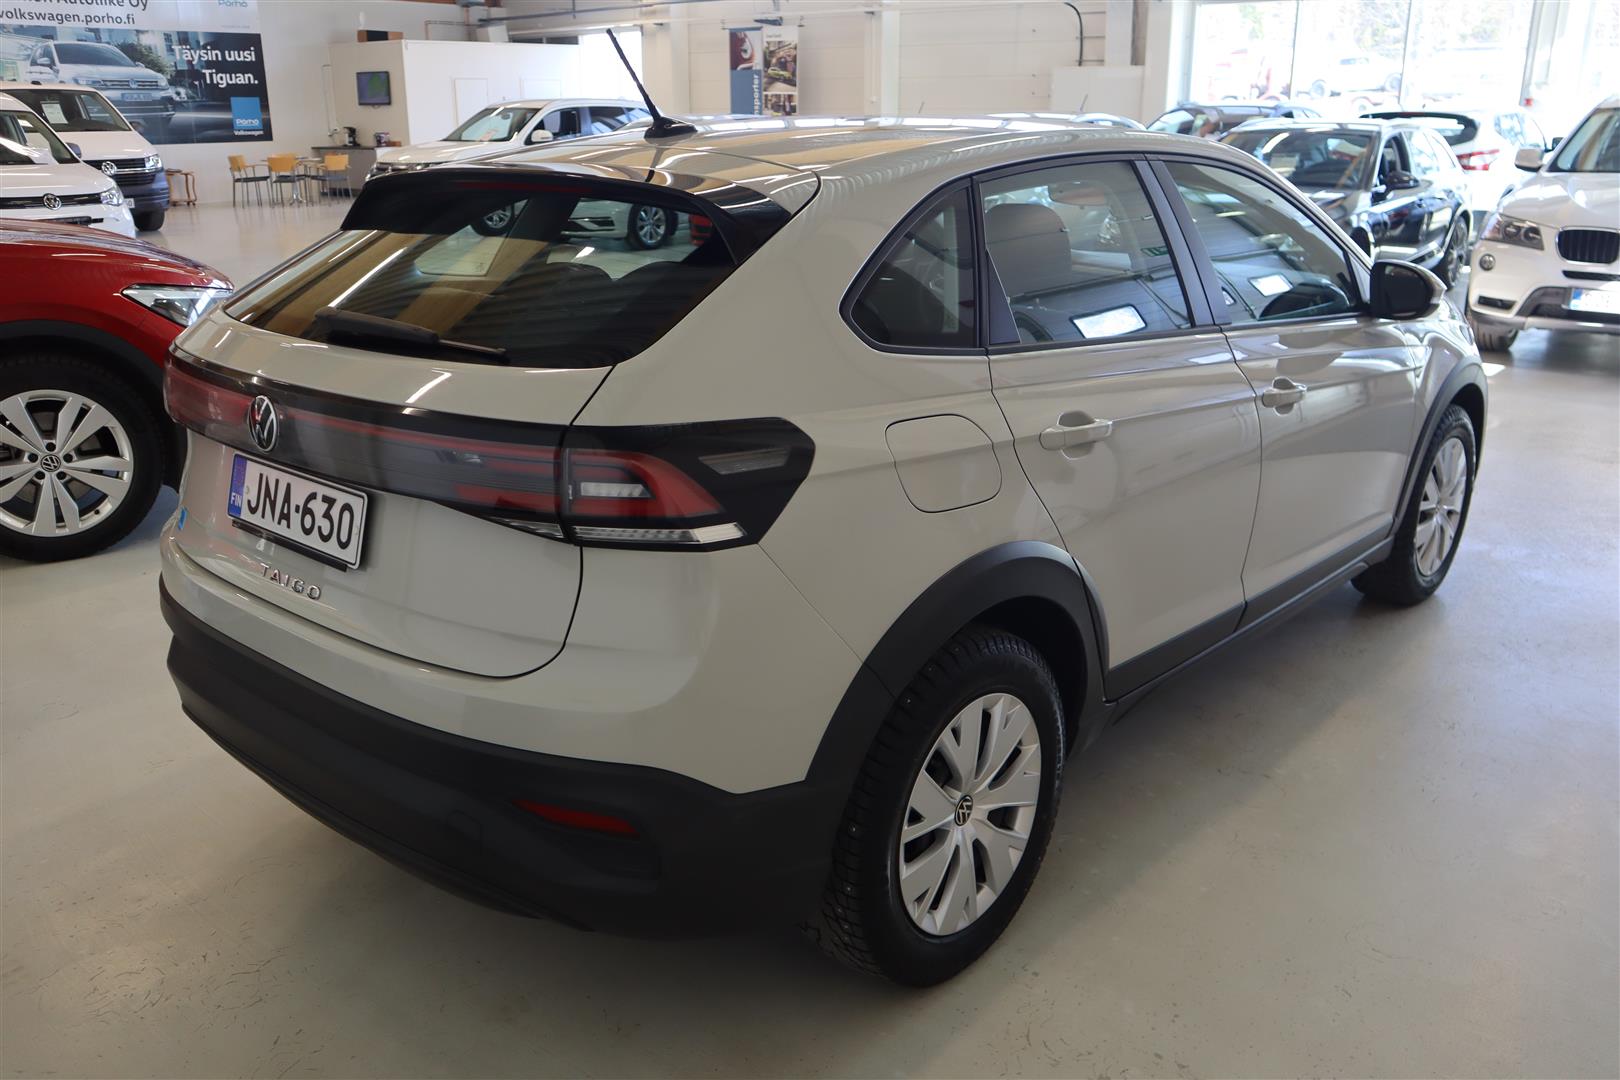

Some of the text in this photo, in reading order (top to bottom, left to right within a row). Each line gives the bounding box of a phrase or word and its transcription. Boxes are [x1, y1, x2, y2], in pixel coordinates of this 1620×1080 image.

[172, 46, 256, 64] Täysin uusi
[202, 69, 259, 88] Tiguan.
[230, 472, 355, 551] FIN JNA-630
[260, 562, 322, 600] TAIGO
